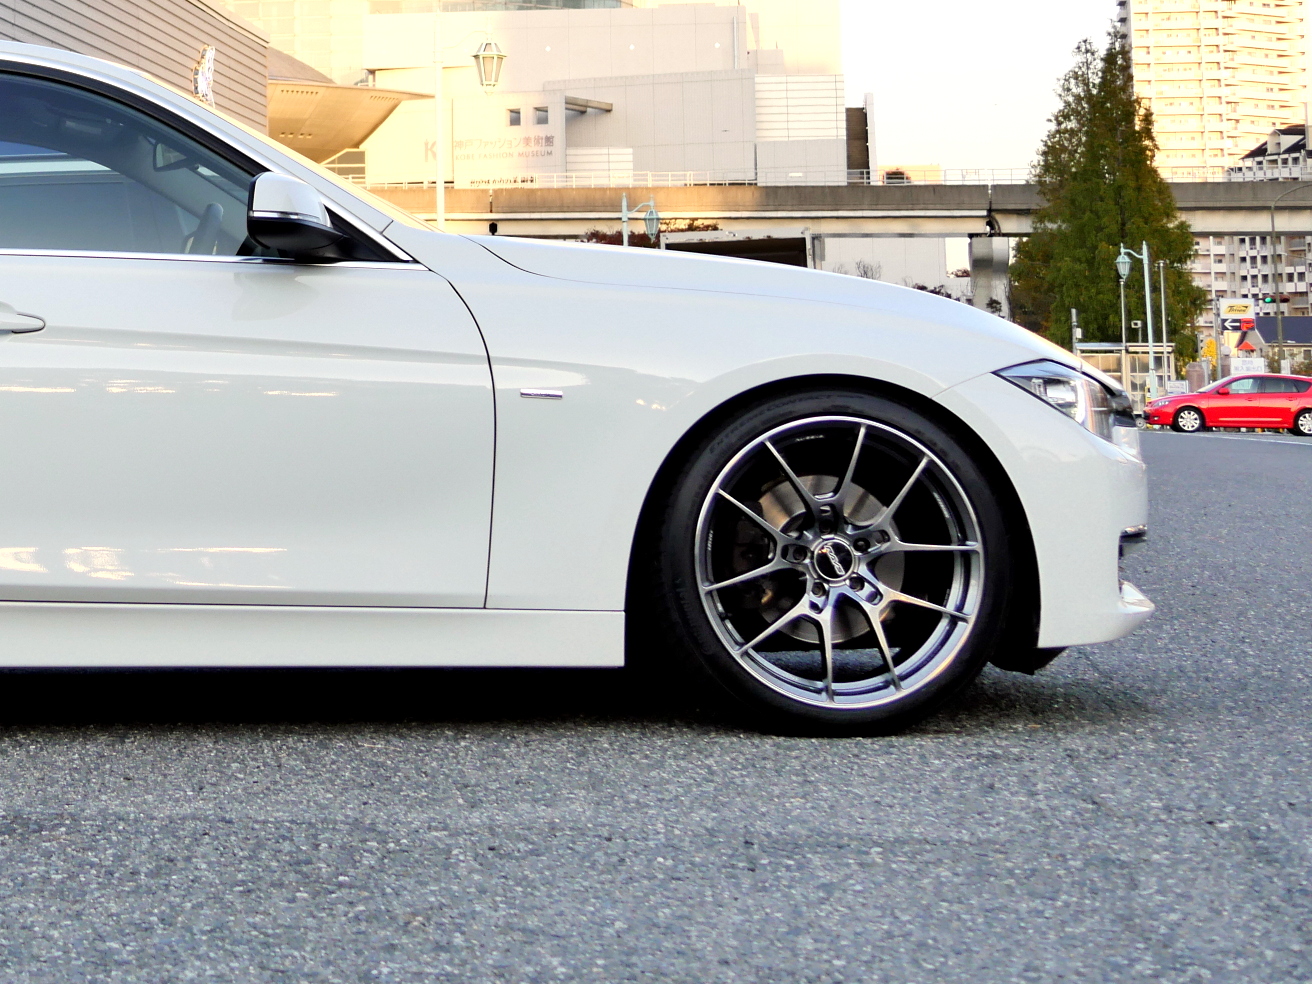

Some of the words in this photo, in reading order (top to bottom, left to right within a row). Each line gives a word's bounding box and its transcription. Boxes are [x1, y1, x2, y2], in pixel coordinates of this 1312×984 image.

[454, 134, 555, 151] 神戸ファッション美術館
[517, 149, 553, 158] MUSEUM
